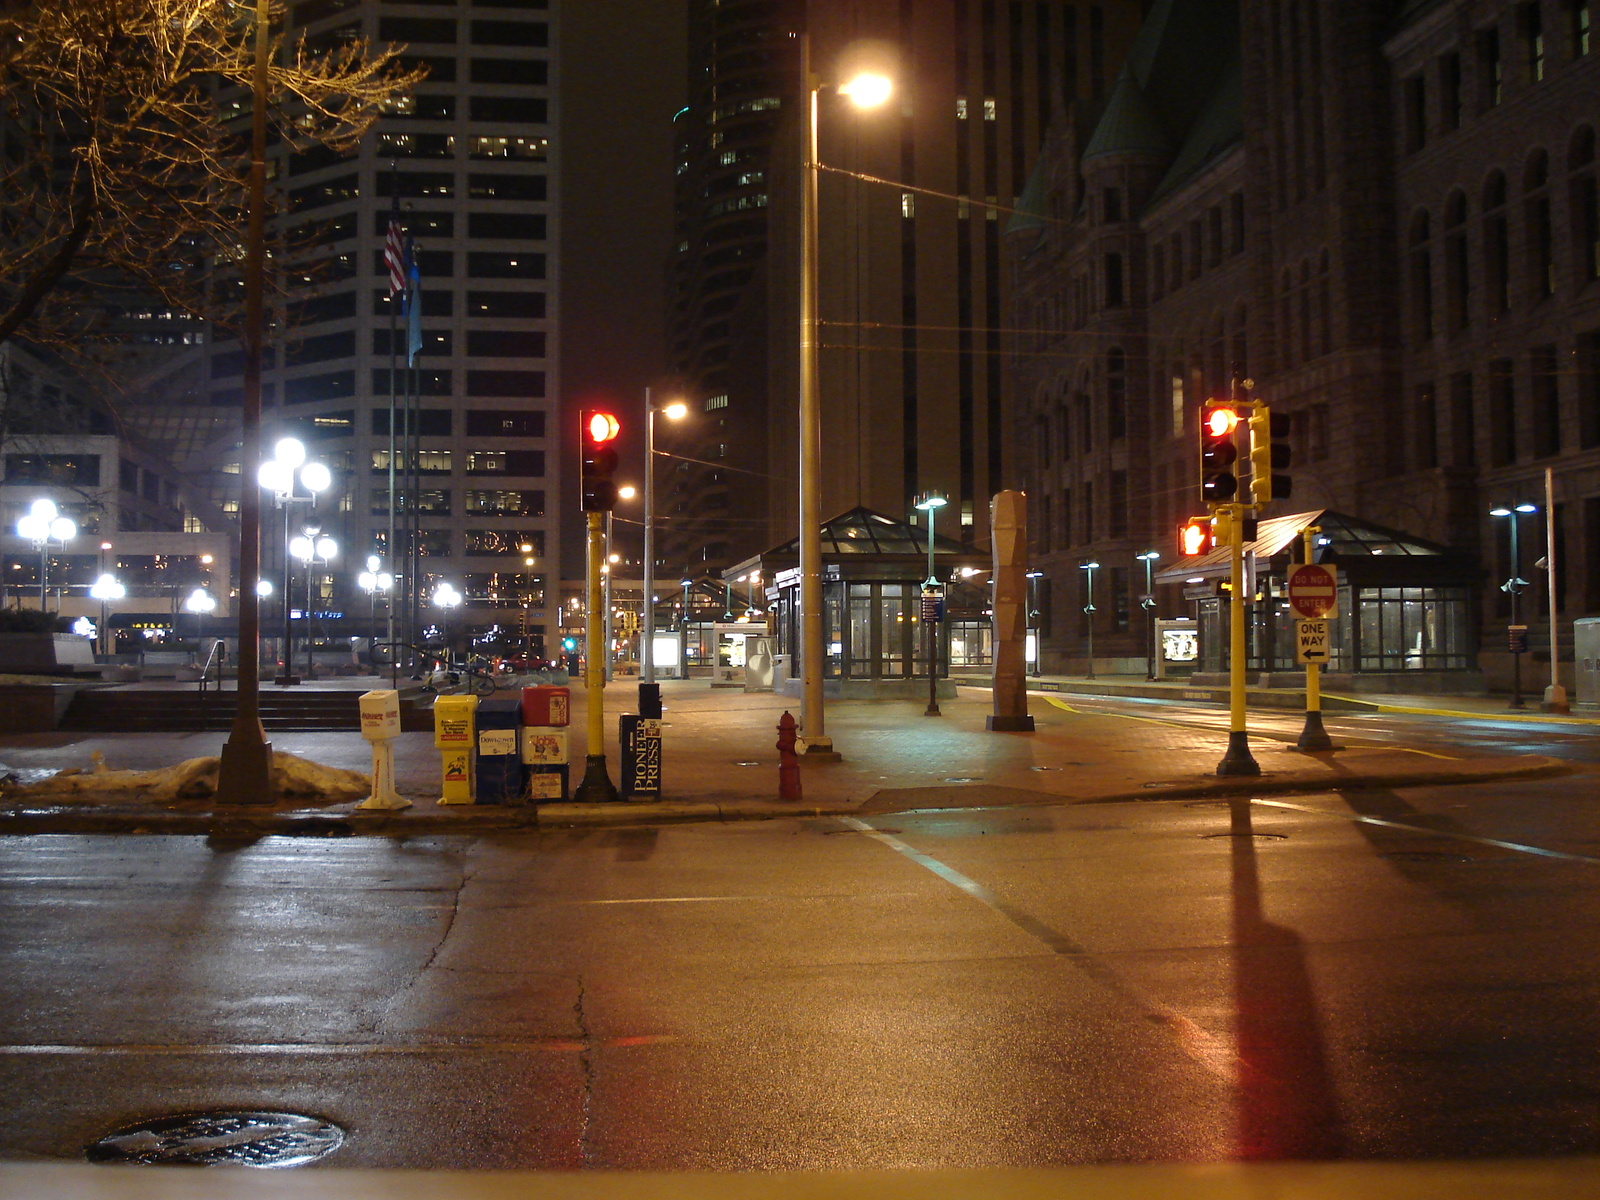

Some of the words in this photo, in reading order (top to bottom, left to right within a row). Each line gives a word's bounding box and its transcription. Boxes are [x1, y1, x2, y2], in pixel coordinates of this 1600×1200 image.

[1295, 575, 1307, 584] DO
[1310, 575, 1328, 584] NOT
[1299, 599, 1327, 608] ENTER
[1301, 623, 1325, 634] ONE
[1301, 636, 1325, 646] WAY
[634, 719, 647, 791] PIONEER
[645, 739, 659, 791] PRESS
